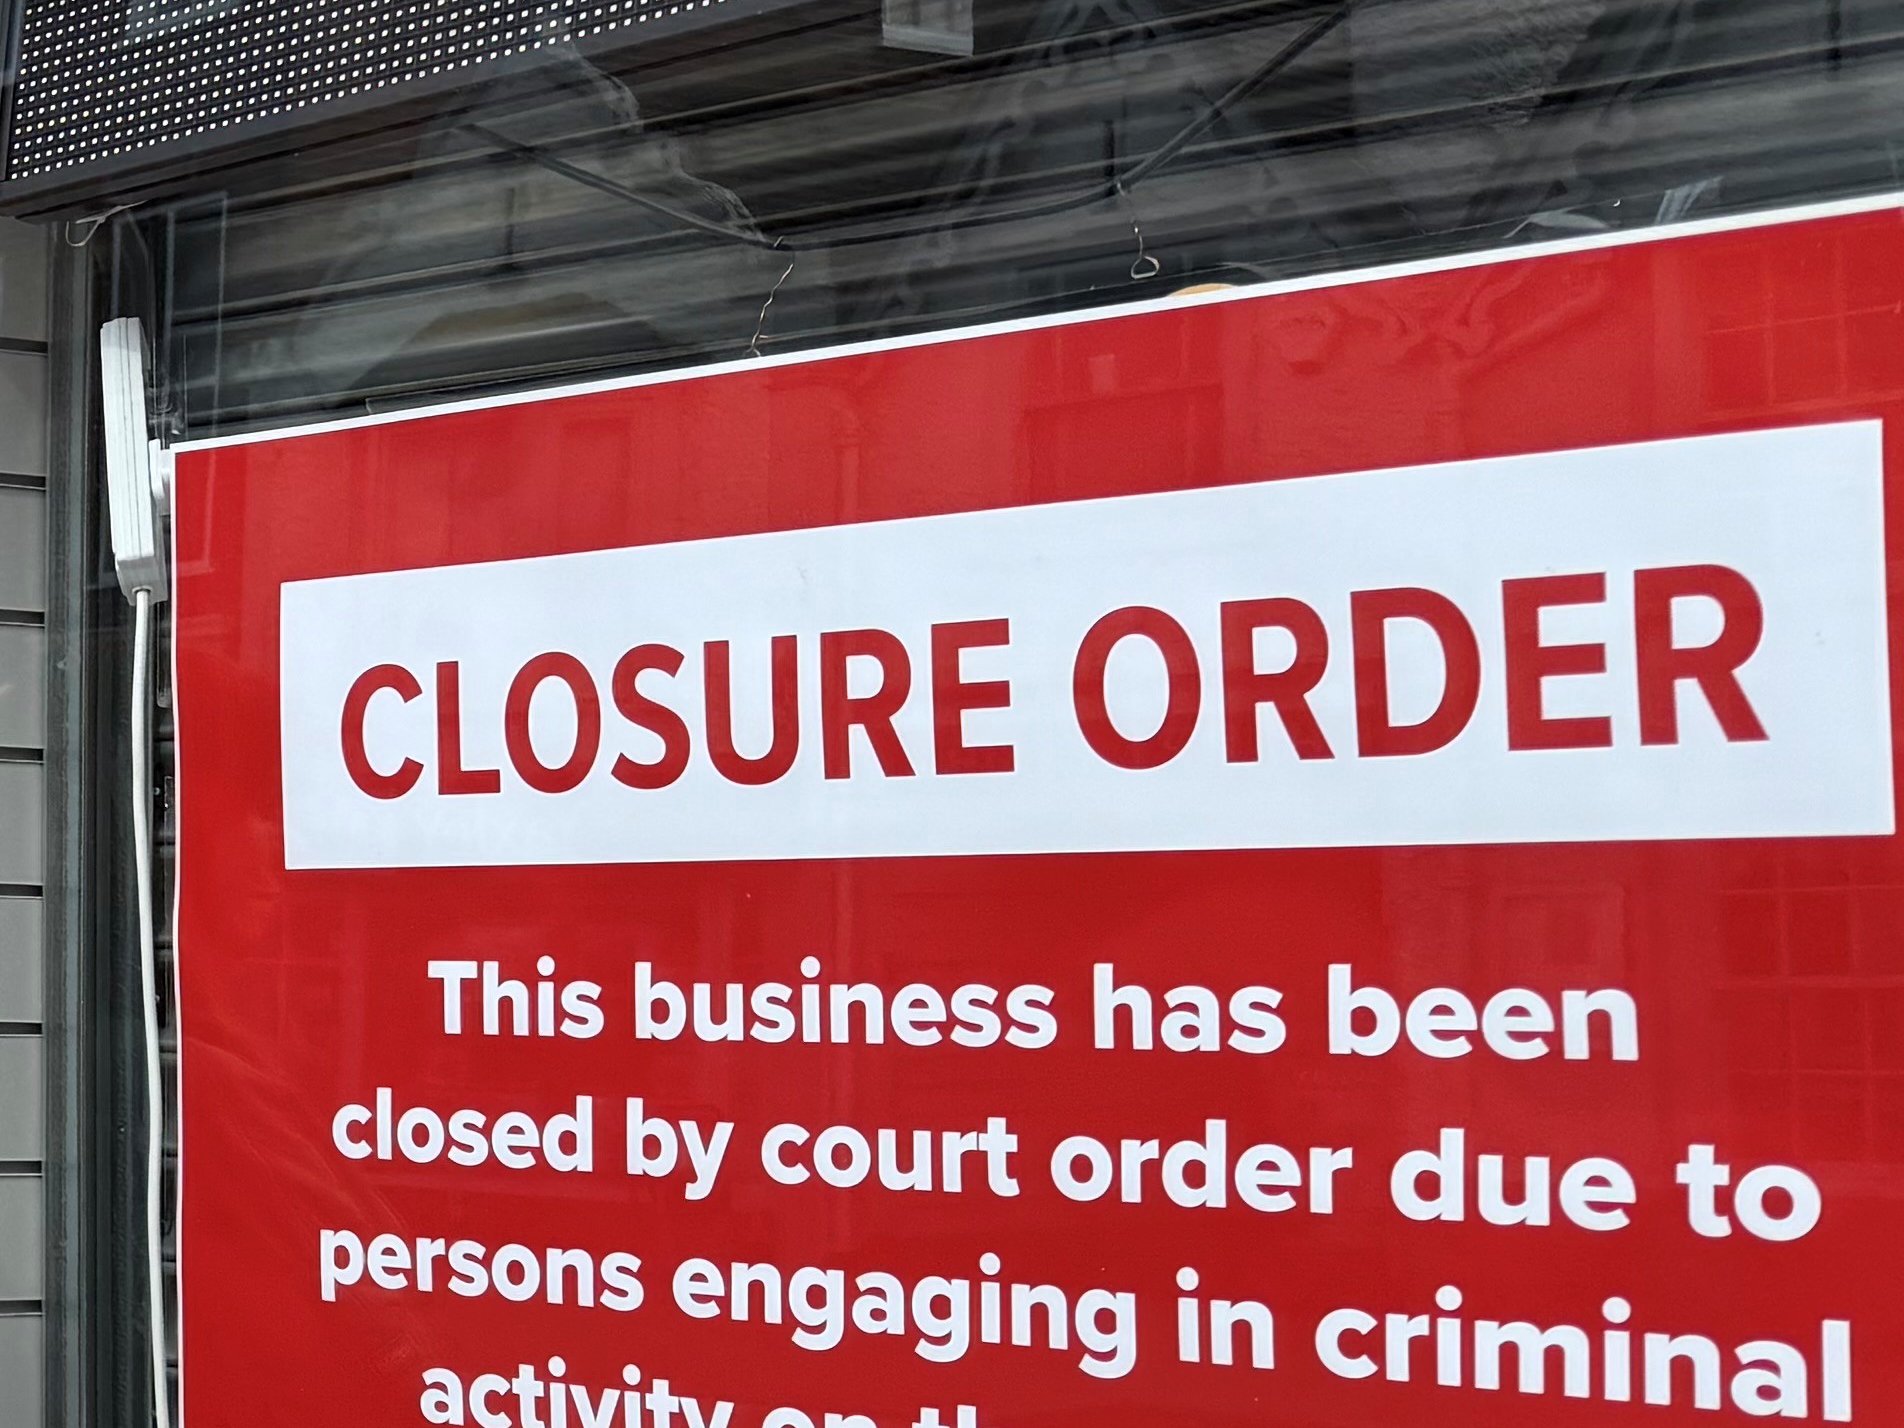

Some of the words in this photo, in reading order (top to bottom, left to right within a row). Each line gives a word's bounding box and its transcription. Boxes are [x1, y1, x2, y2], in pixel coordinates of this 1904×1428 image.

[341, 619, 1015, 800] CLOSURE
[1073, 564, 1768, 770] ORDER
[428, 956, 604, 1038] This
[635, 956, 1057, 1048] business
[1094, 963, 1286, 1053] has
[1329, 964, 1639, 1060] been
[332, 1088, 593, 1172] closed
[626, 1098, 735, 1200] by
[761, 1117, 1019, 1196] court
[1050, 1119, 1353, 1213] order
[1390, 1128, 1637, 1230] due
[1675, 1144, 1822, 1241] to
[320, 1225, 645, 1311] persons
[672, 1253, 1137, 1378] engaging
[1175, 1267, 1275, 1369] in
[1315, 1286, 1852, 1422] criminal
